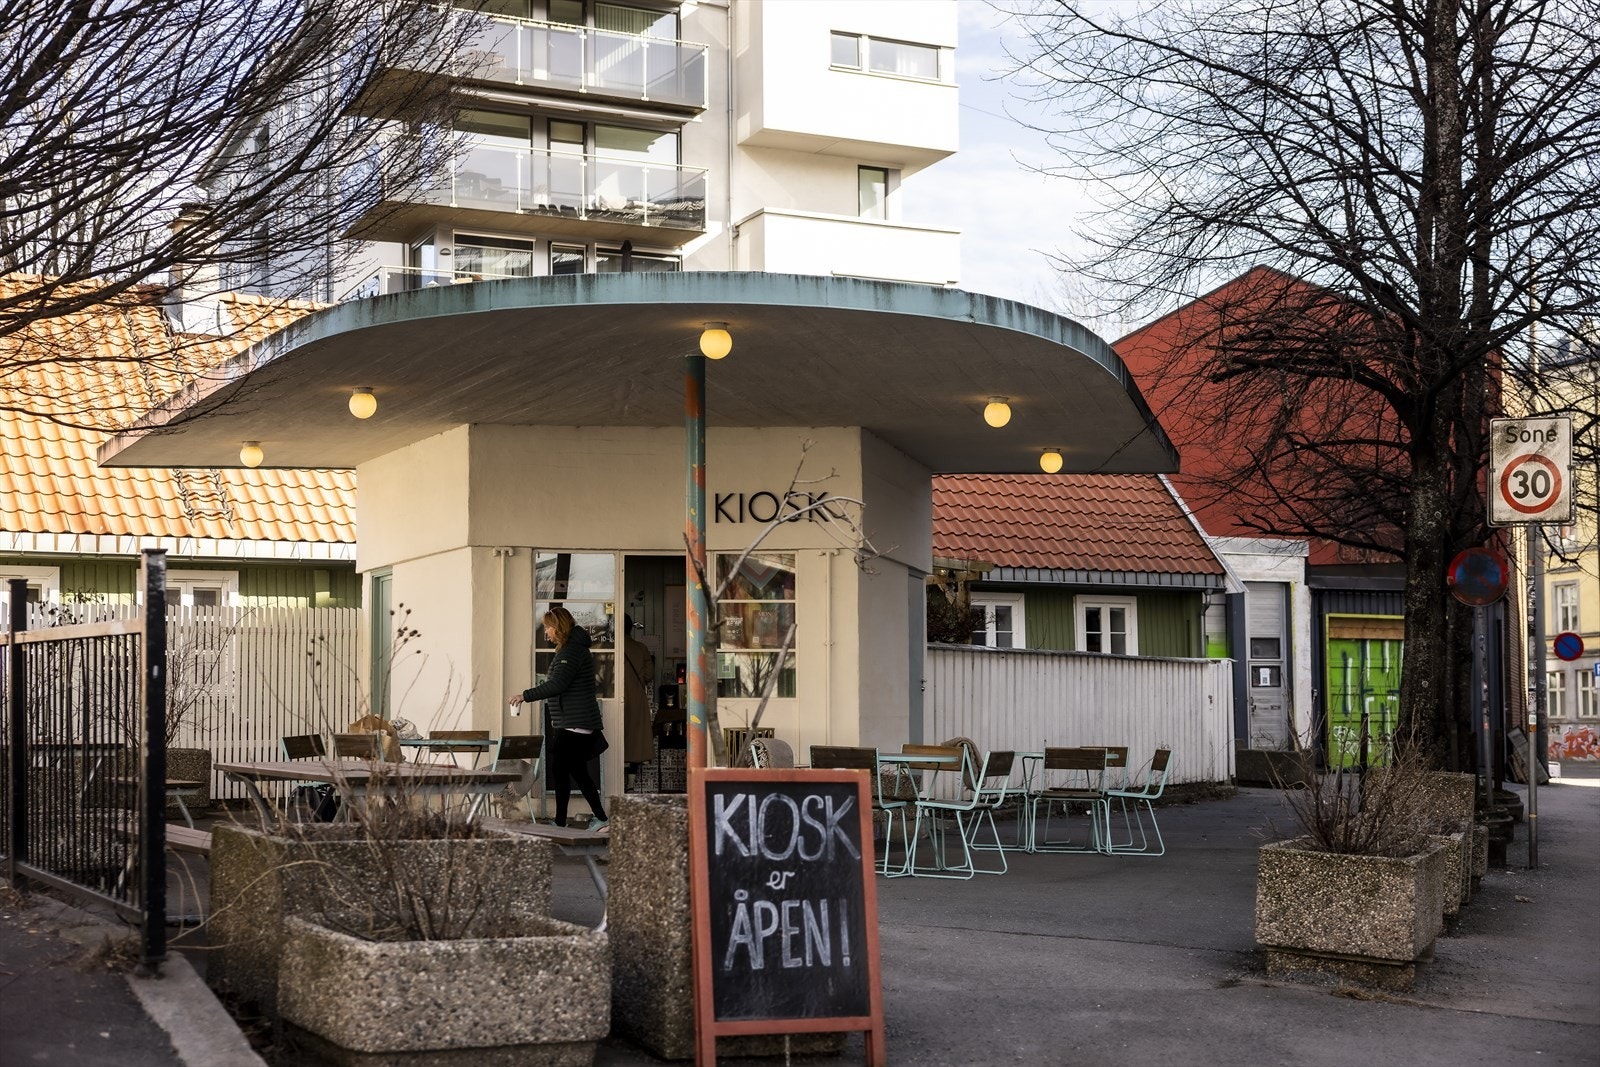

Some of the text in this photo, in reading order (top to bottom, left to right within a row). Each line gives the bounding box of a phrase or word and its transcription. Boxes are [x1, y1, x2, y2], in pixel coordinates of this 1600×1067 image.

[1505, 425, 1557, 444] Sone
[1512, 469, 1551, 499] 30
[715, 491, 829, 524] KIOSK
[713, 793, 861, 861] KIOSK
[766, 870, 796, 890] er
[723, 889, 851, 971] ÅPEN!
